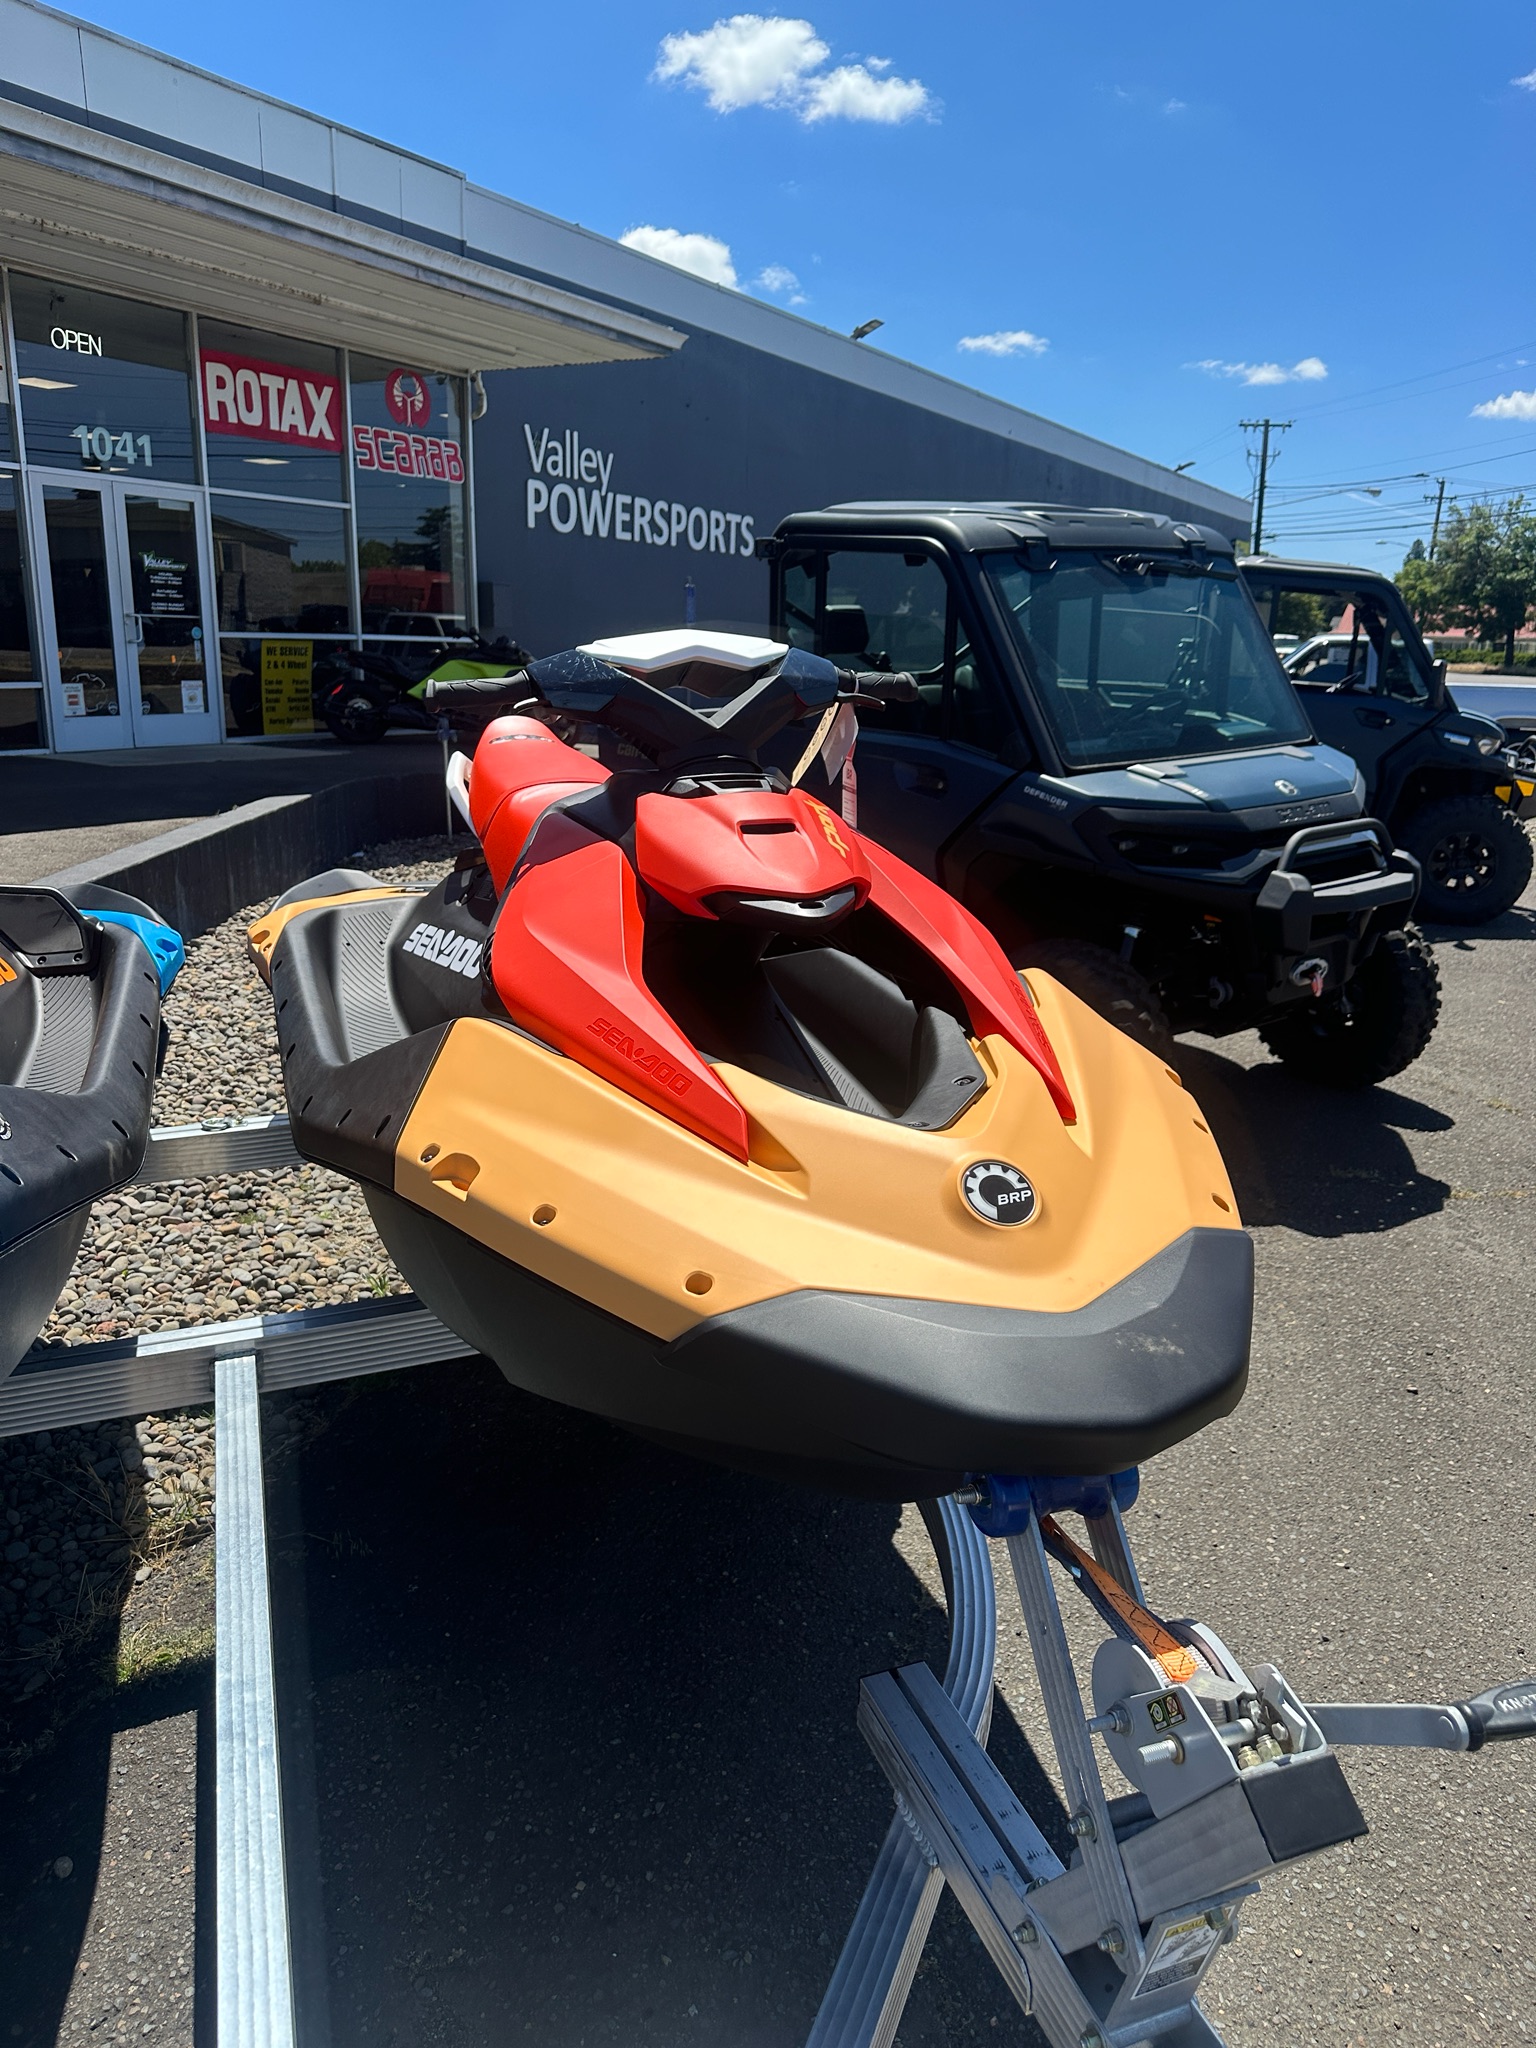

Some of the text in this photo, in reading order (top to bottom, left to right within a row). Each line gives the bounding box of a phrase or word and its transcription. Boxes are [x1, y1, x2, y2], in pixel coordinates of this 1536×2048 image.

[51, 327, 102, 357] OPEN
[205, 361, 335, 441] ROTAX
[72, 424, 153, 467] 1041
[523, 423, 614, 496] Valley
[526, 478, 755, 557] POWERSPORTS
[266, 646, 308, 656] WE SERVICE
[266, 661, 271, 669] 2
[281, 661, 285, 669] 4
[1023, 785, 1069, 807] DEFENDER
[997, 1189, 1032, 1206] BRP
